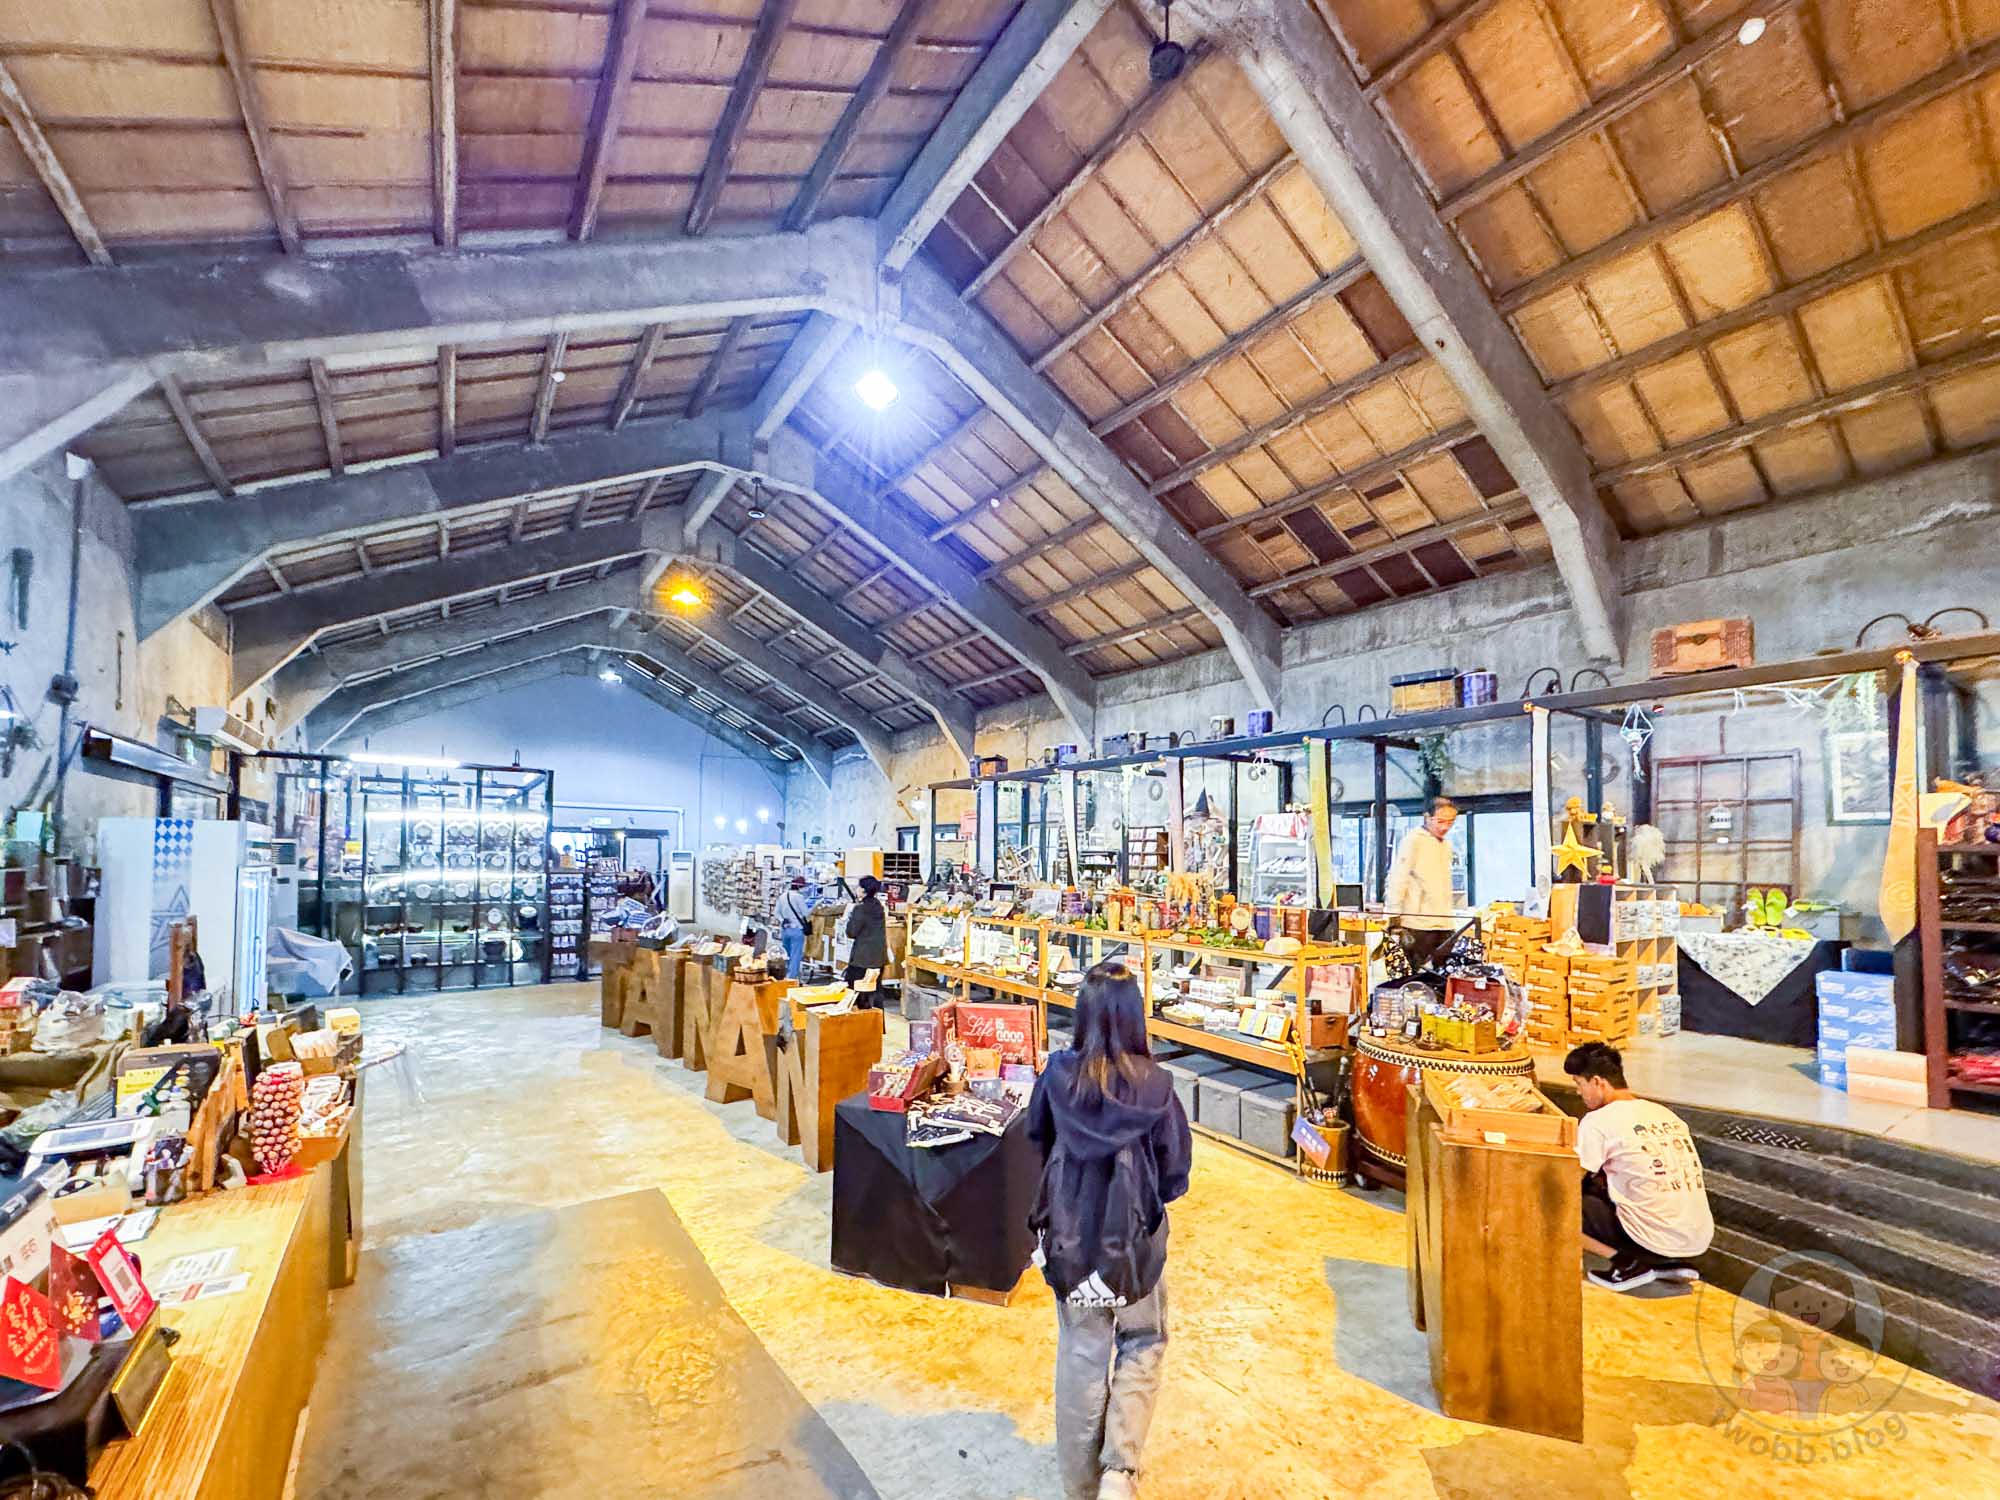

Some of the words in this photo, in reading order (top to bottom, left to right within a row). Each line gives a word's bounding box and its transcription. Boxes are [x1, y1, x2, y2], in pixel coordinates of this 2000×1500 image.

[963, 1015, 994, 1043] Life
[995, 1030, 1024, 1042] GOOD
[588, 942, 840, 1173] TAINAN
